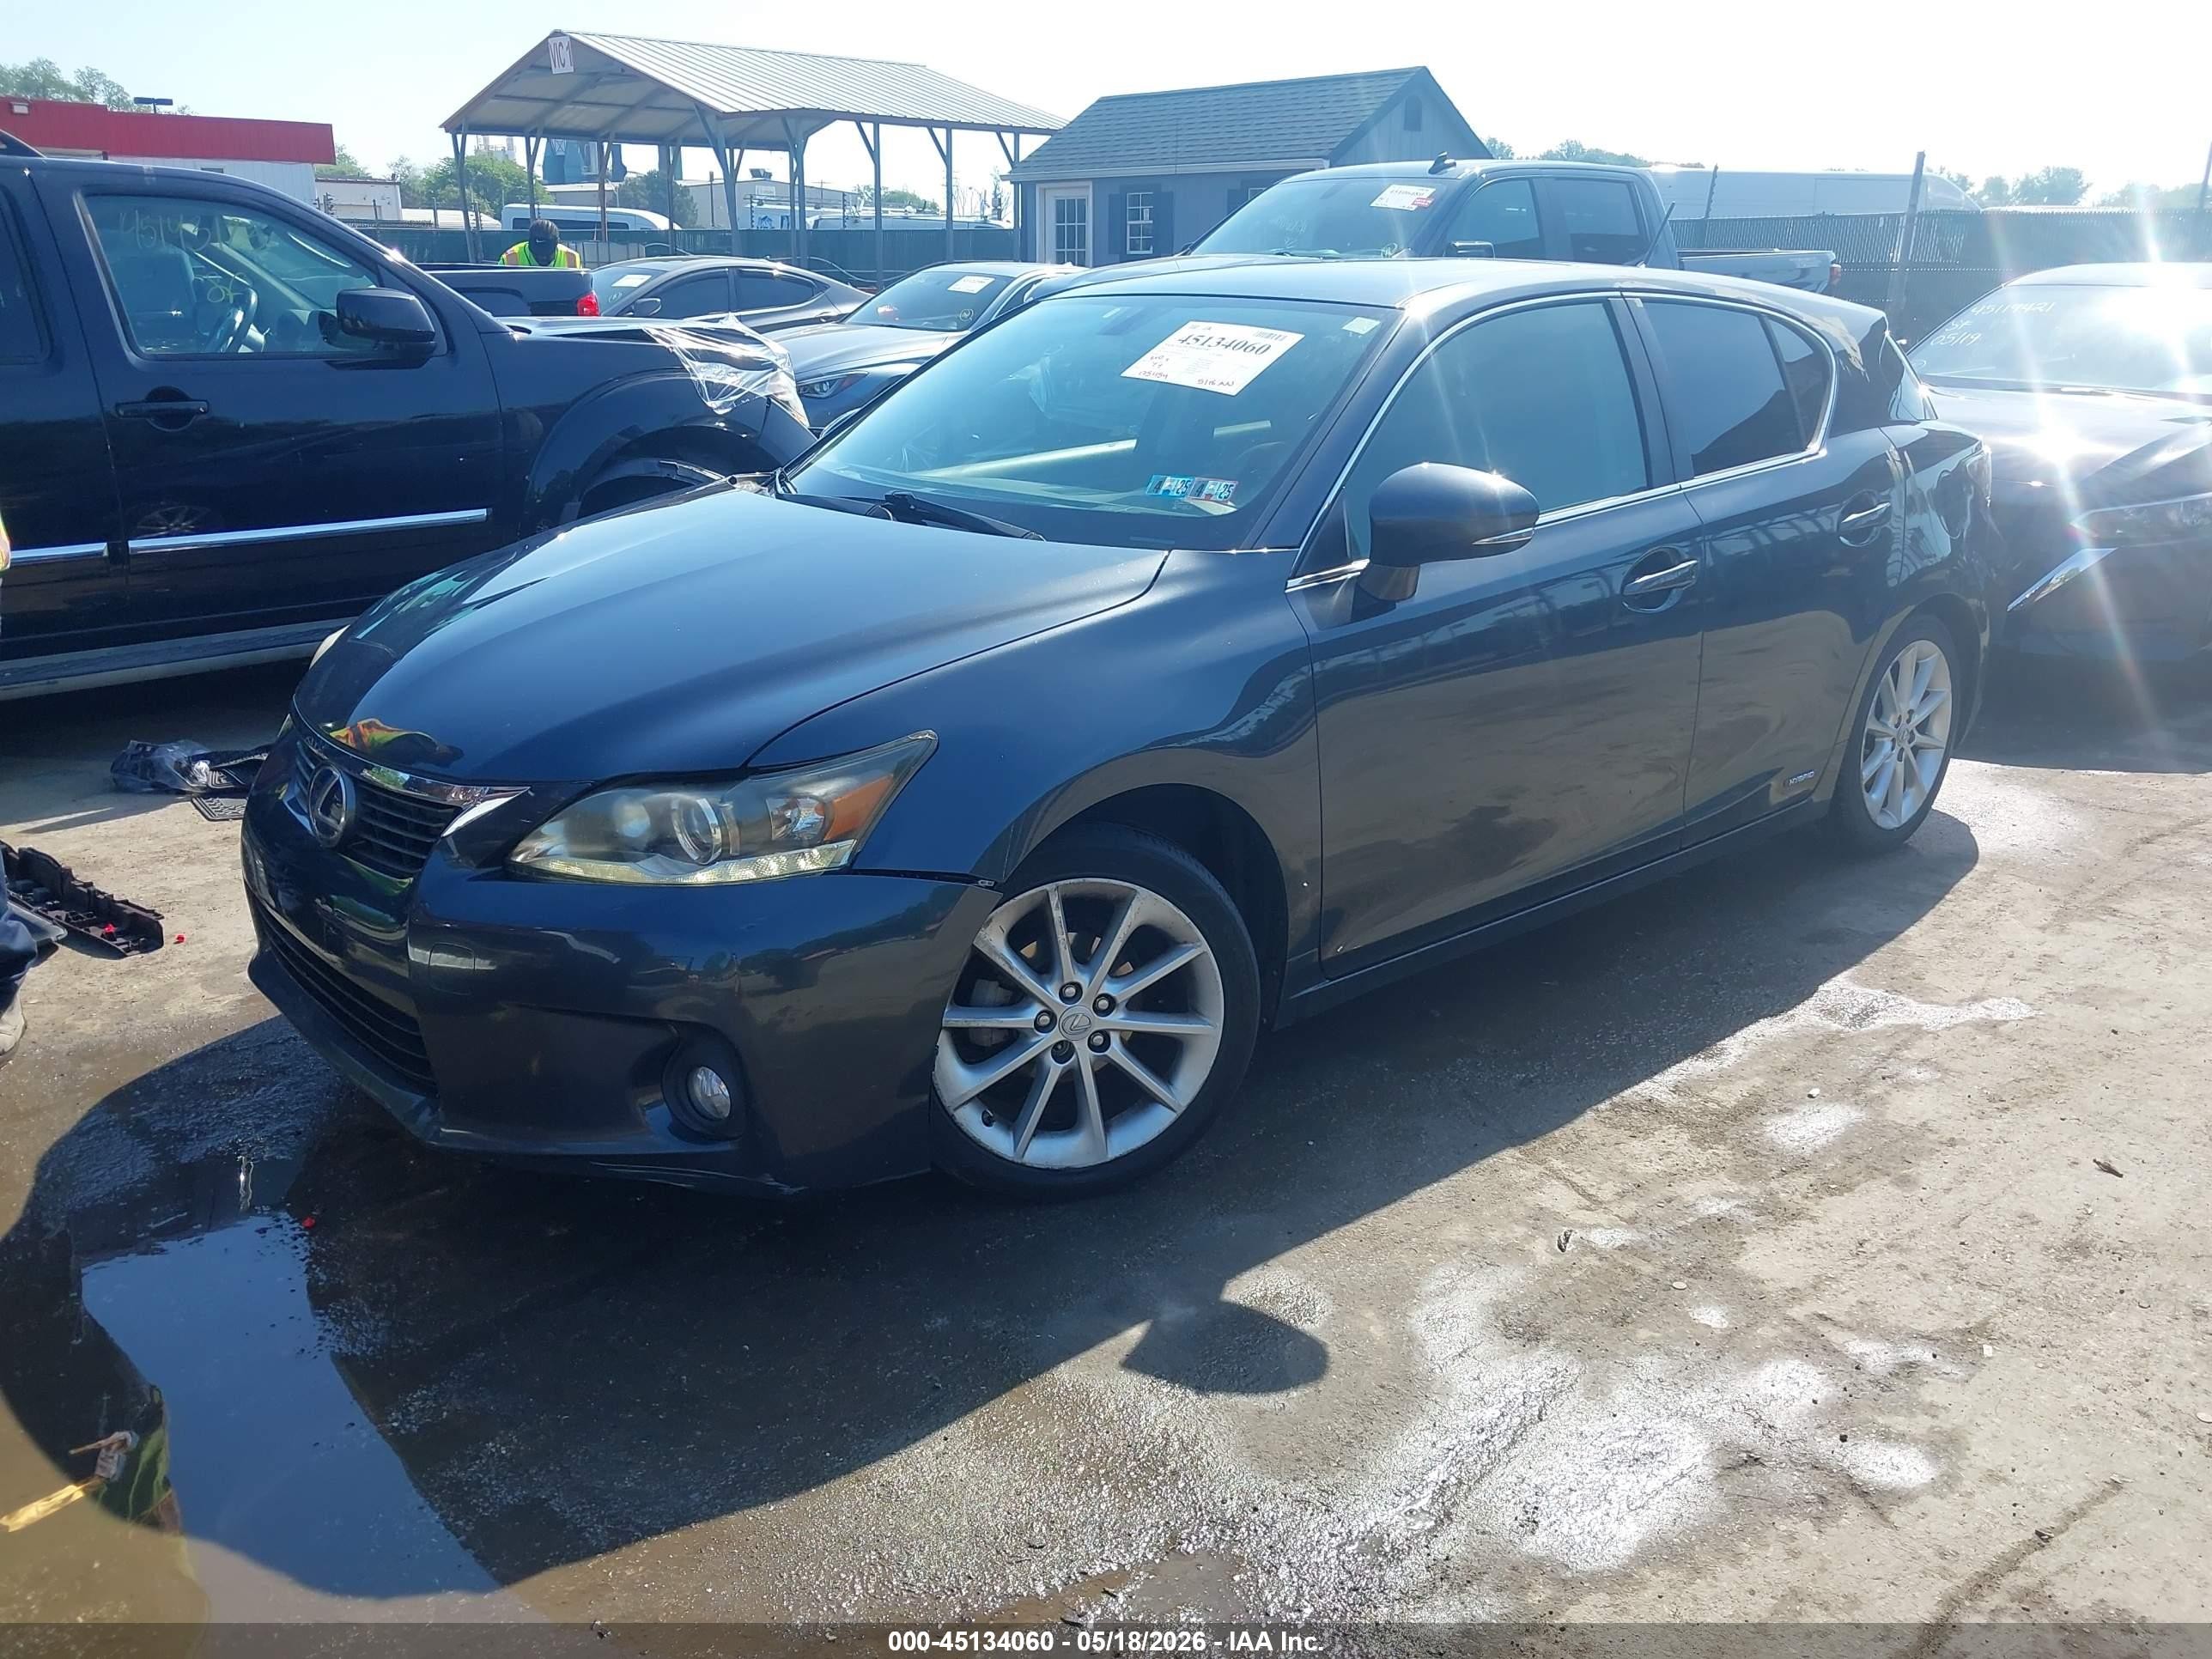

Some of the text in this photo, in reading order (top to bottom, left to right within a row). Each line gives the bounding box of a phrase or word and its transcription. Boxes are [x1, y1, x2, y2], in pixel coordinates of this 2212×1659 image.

[1177, 333, 1272, 356] 45134060
[1176, 479, 1191, 495] 25
[1218, 483, 1234, 500] 25
